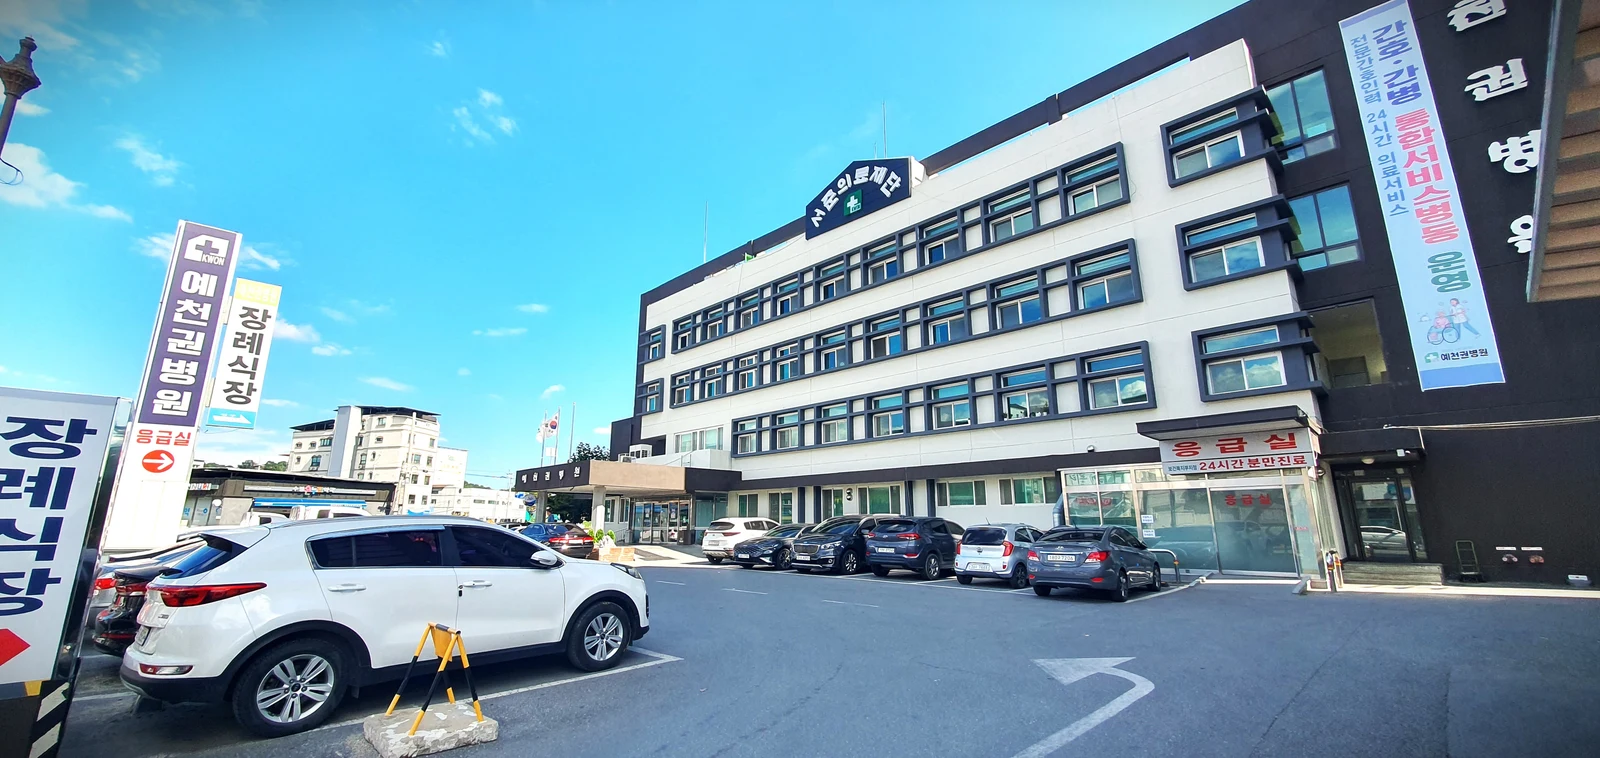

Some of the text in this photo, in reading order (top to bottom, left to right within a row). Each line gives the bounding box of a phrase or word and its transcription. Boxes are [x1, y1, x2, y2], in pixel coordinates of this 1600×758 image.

[1350, 34, 1409, 217] 전문간호인력 24시간 의료서비스
[1395, 108, 1460, 244] 통합서비스병동
[202, 254, 225, 266] KWON
[1427, 251, 1471, 293] 운영
[152, 270, 218, 417] 예천권병원
[222, 305, 272, 405] 장례식장
[1441, 348, 1488, 361] 예천권병원
[136, 429, 192, 447] 응급실
[1172, 433, 1298, 457] 응급실
[1199, 458, 1244, 470] 24시간
[1247, 455, 1307, 468] 분만진료
[0, 417, 97, 616] 장례식장
[1225, 494, 1272, 506] 응급실
